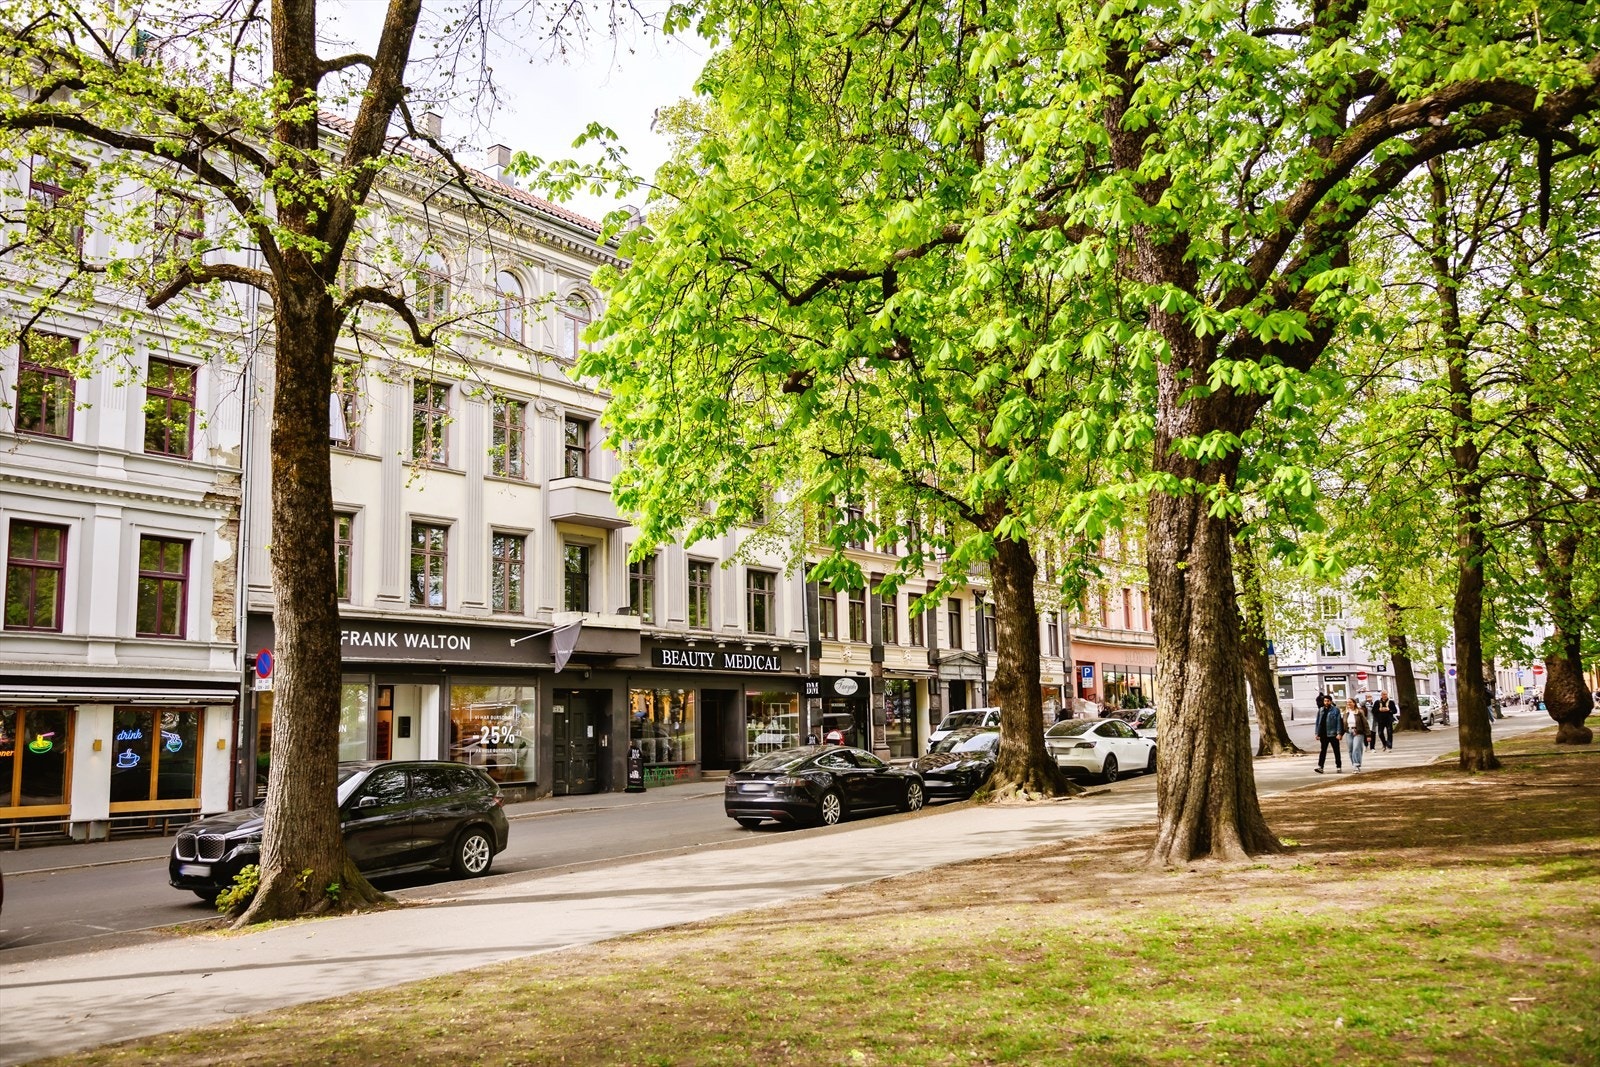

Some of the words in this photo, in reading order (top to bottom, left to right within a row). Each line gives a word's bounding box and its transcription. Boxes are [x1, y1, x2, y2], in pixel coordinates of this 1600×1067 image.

[340, 630, 398, 648] FRANK
[404, 633, 471, 650] WALTON
[661, 649, 715, 668] BEAUTY
[724, 653, 780, 671] MEDICAL
[1084, 667, 1091, 677] P
[116, 728, 143, 741] drink
[472, 725, 515, 745] -25%
